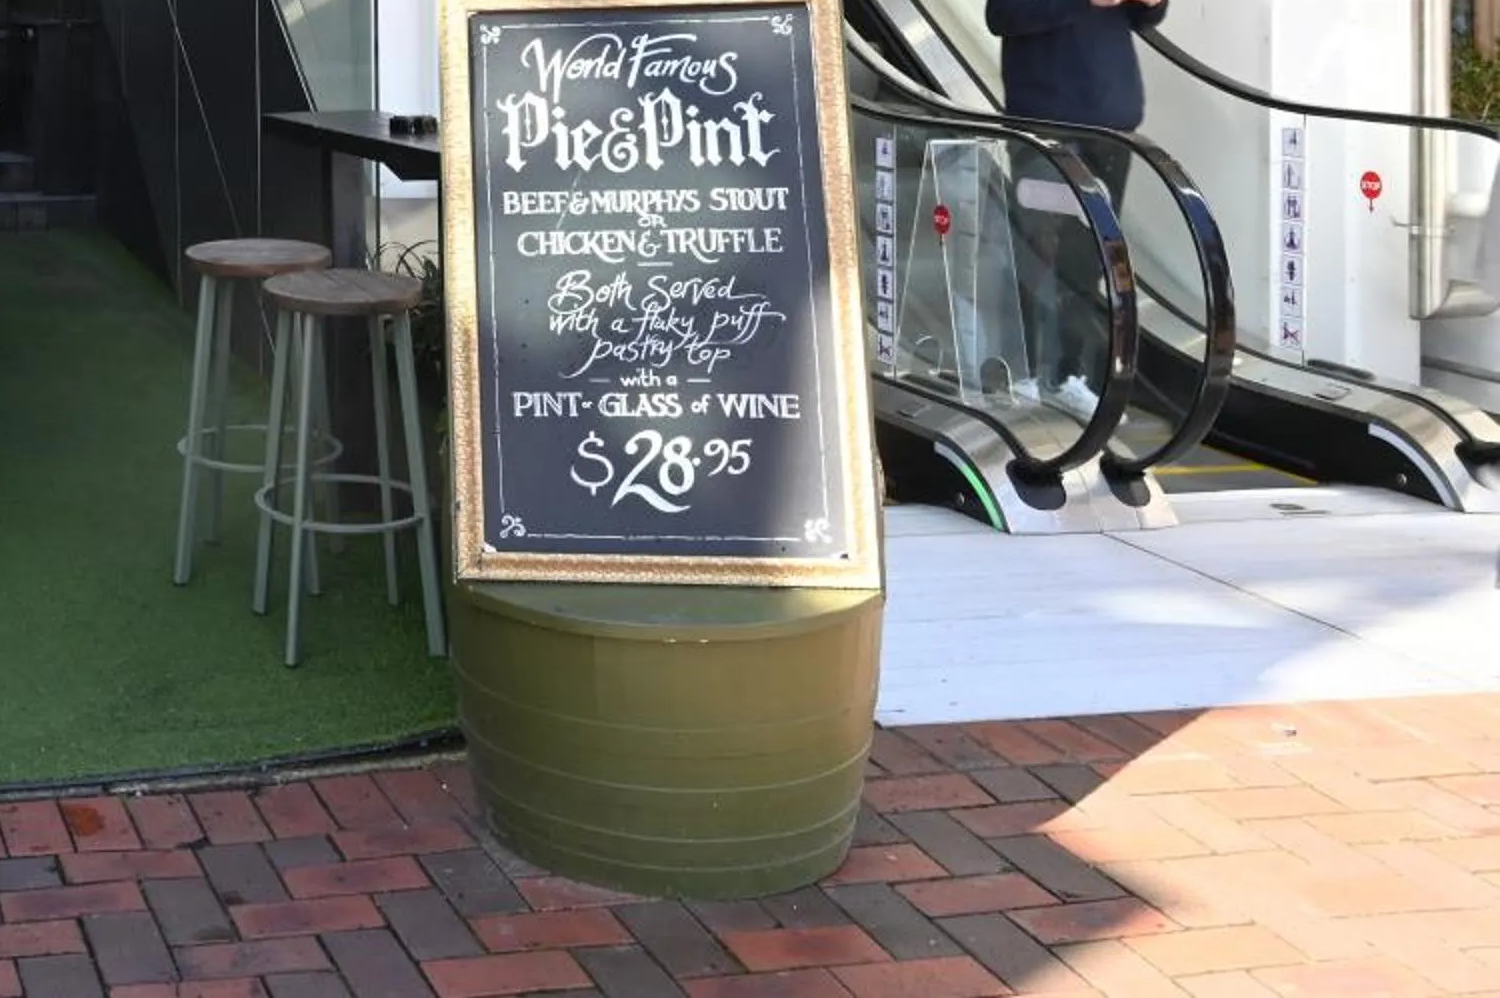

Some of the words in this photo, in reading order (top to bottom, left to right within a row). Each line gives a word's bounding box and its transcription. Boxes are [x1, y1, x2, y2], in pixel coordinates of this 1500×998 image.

[520, 33, 626, 103] World
[627, 33, 738, 95] Famous
[709, 187, 788, 211] STOUT
[548, 270, 636, 314] Both
[642, 275, 766, 312] Served
[550, 307, 599, 338] with
[611, 316, 629, 333] a
[632, 302, 698, 349] flaky
[698, 301, 787, 346] puff
[558, 334, 674, 378] pastry
[684, 335, 731, 374] top
[620, 367, 661, 387] with
[665, 375, 678, 387] a
[512, 391, 583, 417] PINT
[598, 392, 683, 418] GLASS
[691, 393, 712, 414] of
[716, 393, 801, 419] WINE
